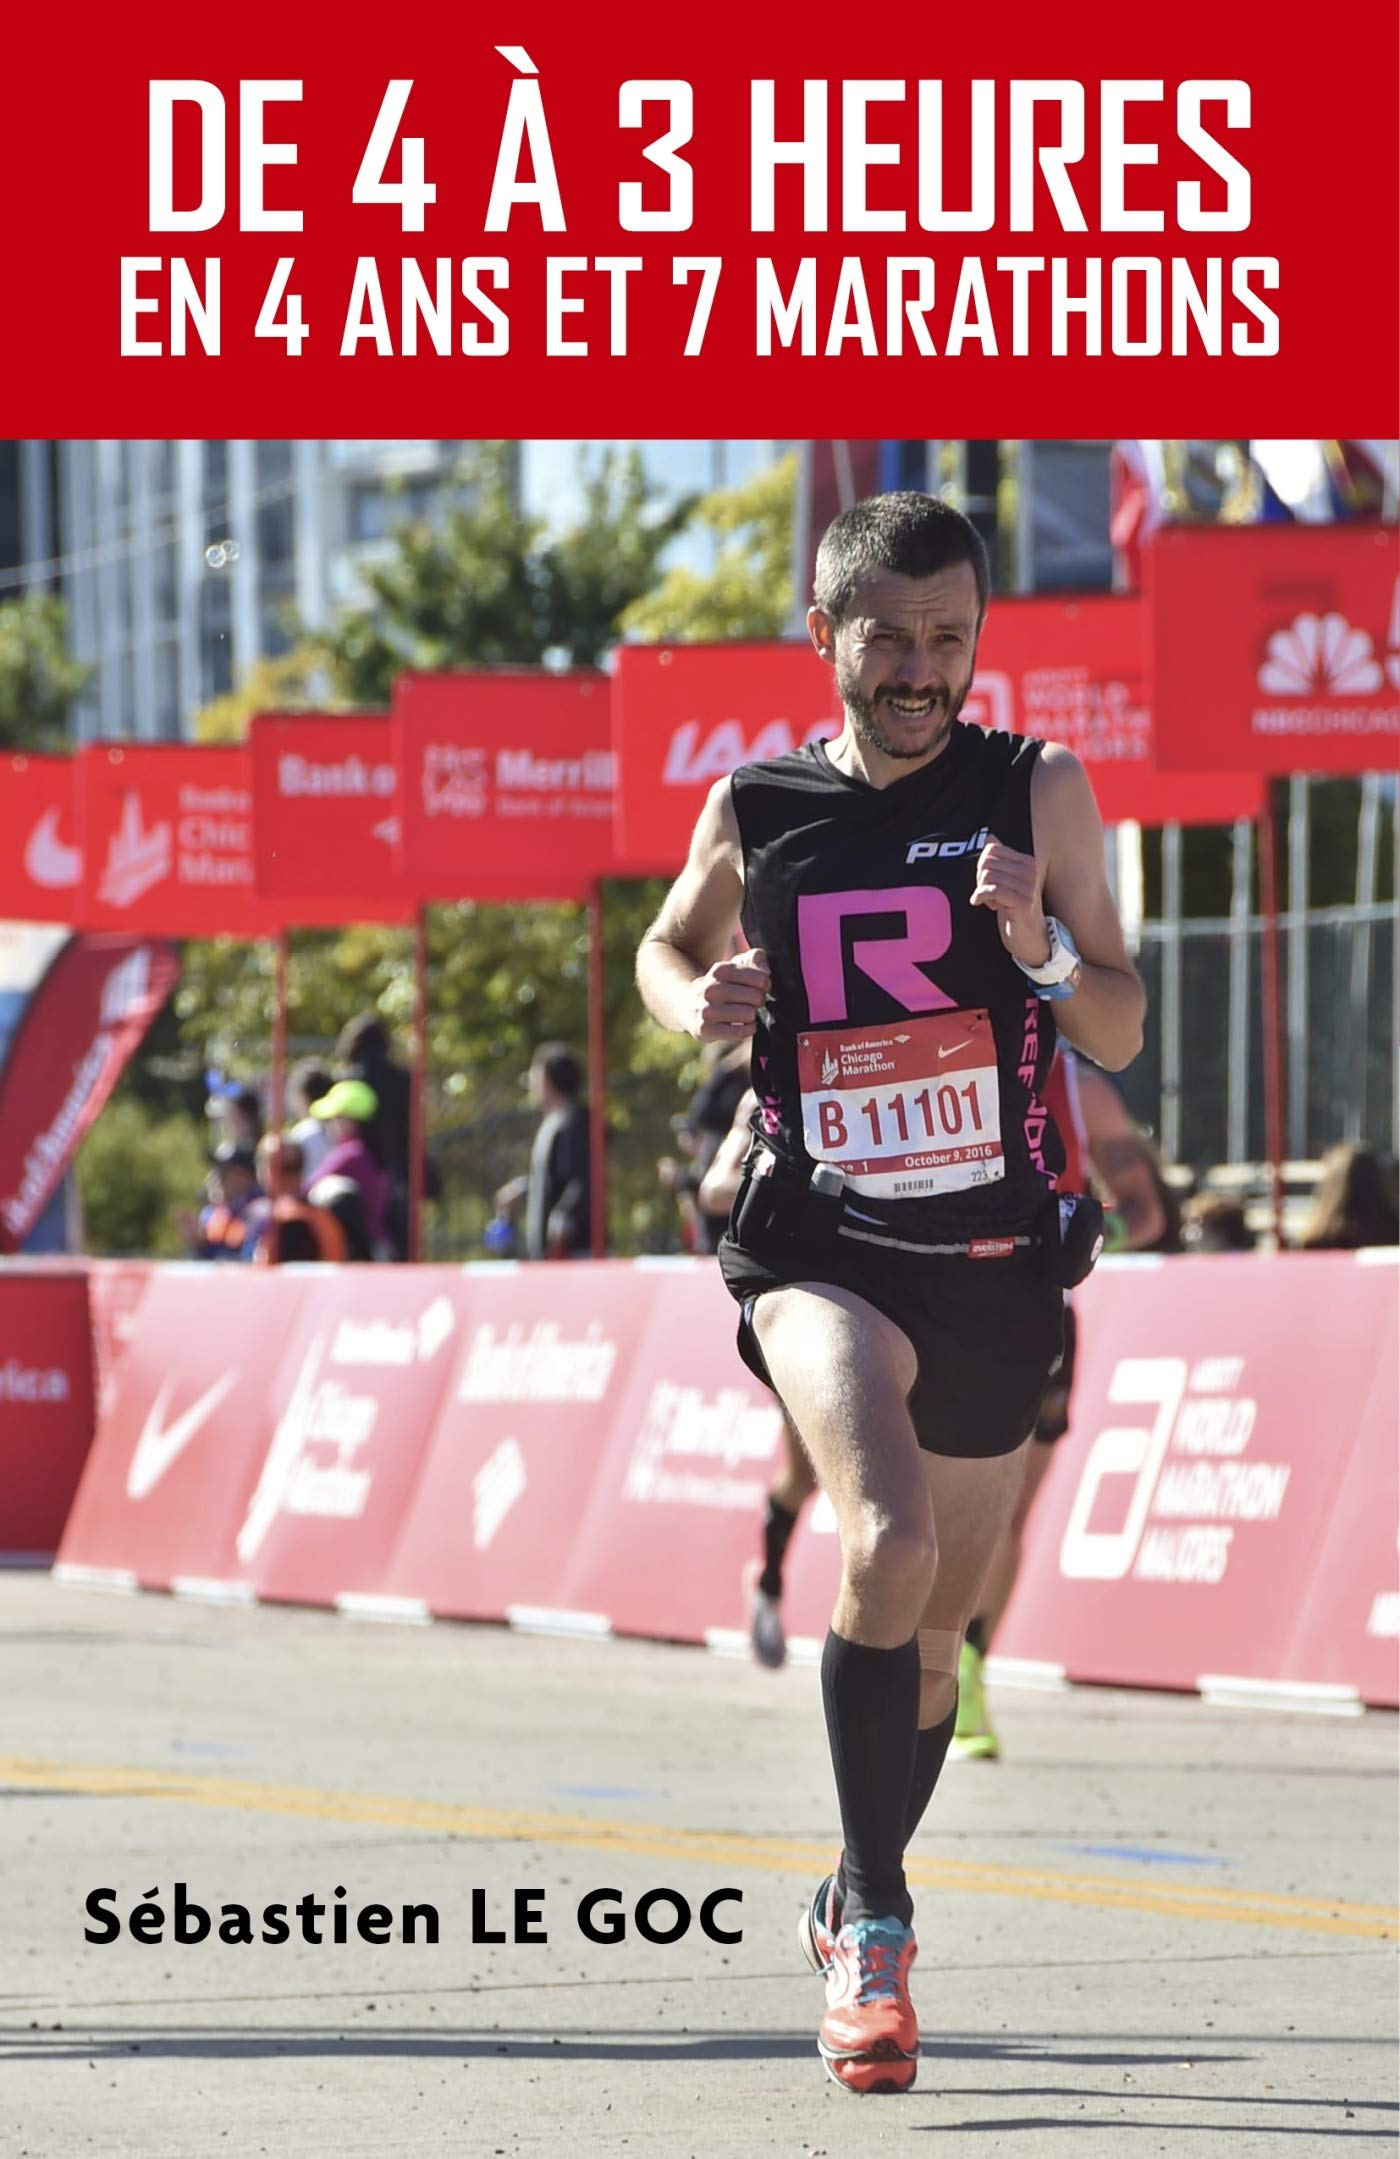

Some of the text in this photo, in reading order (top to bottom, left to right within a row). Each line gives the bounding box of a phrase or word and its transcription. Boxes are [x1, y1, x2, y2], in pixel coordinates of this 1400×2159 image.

[278, 754, 369, 797] Bank
[905, 827, 990, 865] poli
[797, 885, 961, 1025] R
[839, 1038, 894, 1053] Bank of America
[840, 1051, 883, 1065] Chicago
[842, 1061, 895, 1077] Marathon
[818, 1100, 848, 1150] B
[861, 1081, 983, 1146] 11101
[861, 1161, 869, 1173] 1
[904, 1154, 952, 1169] October
[953, 1151, 963, 1164] 9,
[965, 1145, 993, 1161] 2016
[970, 1170, 988, 1183] 223
